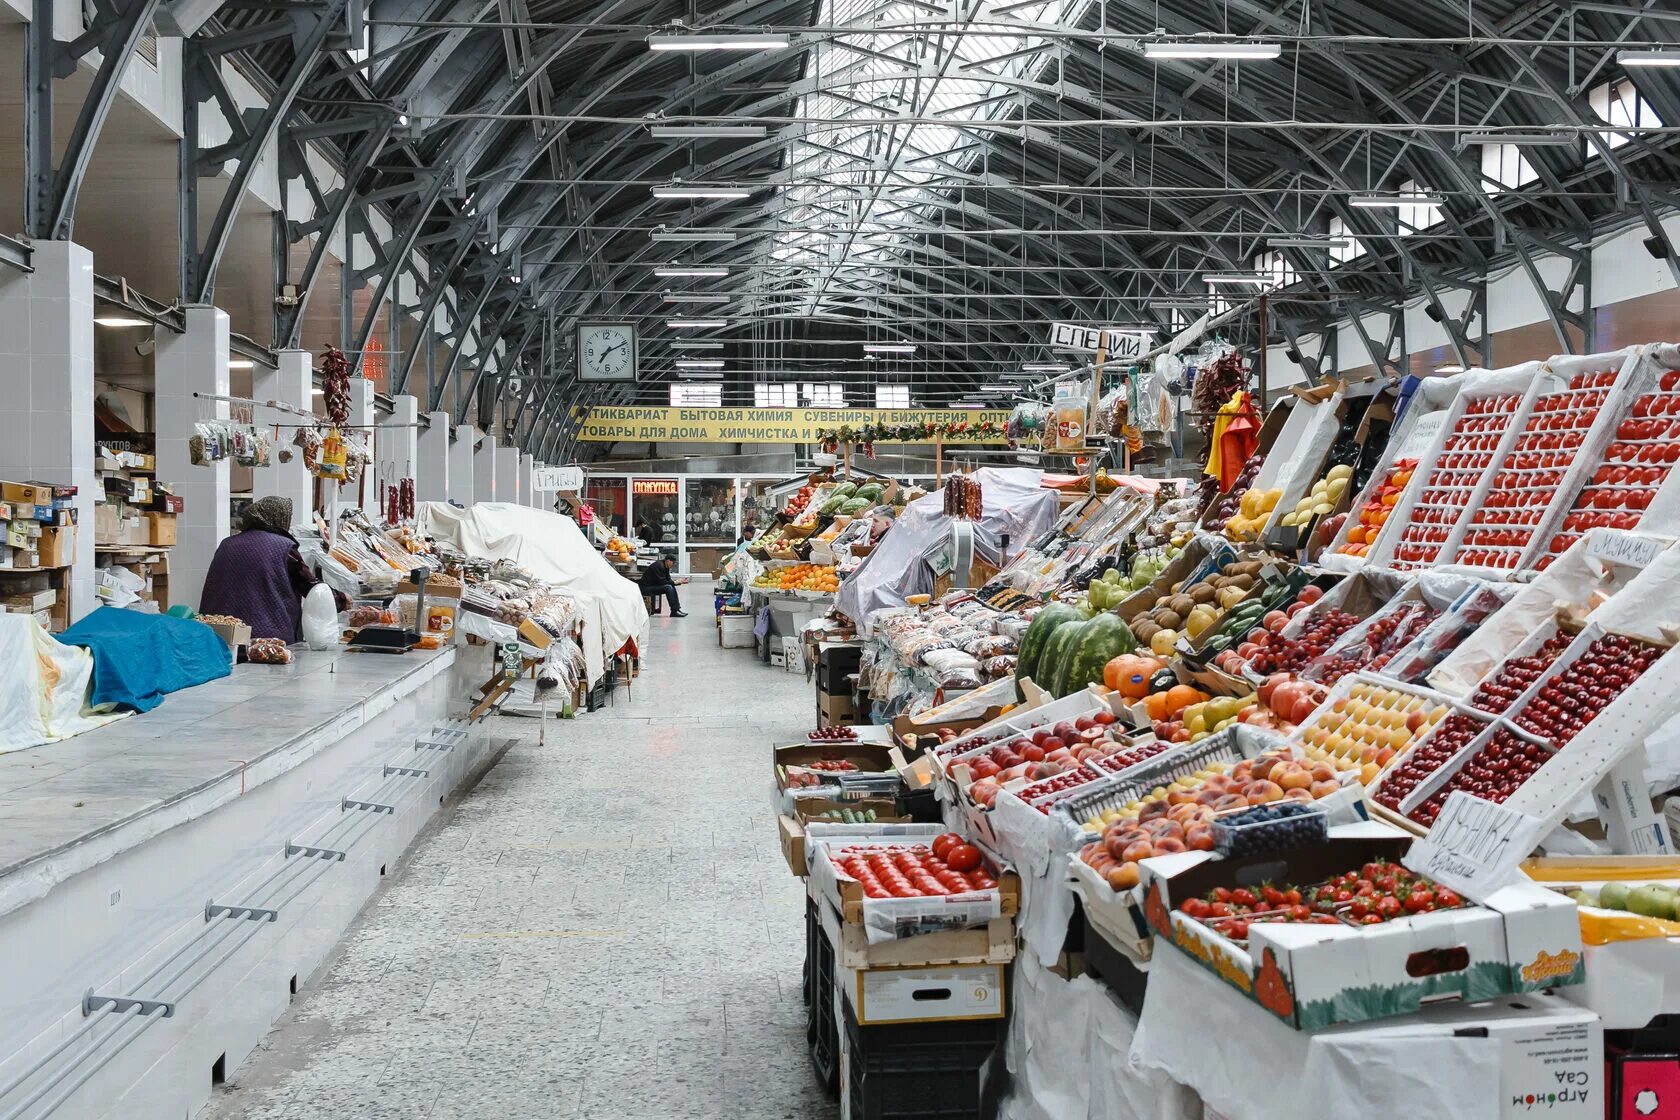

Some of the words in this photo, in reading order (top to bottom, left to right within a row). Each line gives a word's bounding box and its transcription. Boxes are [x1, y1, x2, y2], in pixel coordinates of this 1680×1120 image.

[602, 331, 611, 340] 12
[1055, 325, 1141, 356] СПЕЦИИ
[588, 348, 594, 357] 9
[620, 347, 627, 356] 3
[604, 363, 611, 372] 6
[680, 410, 743, 421] БЫТОВАЯ
[748, 411, 793, 422] ХИМИЯ
[804, 411, 874, 422] СУВЕНИРЫ
[880, 412, 887, 422] И
[891, 412, 968, 423] БИЖУТЕРИЯ
[582, 425, 635, 437] ТОВАРЫ
[639, 426, 666, 439] ДЛЯ
[670, 427, 708, 440] ДОМА
[719, 428, 798, 439] ХИМЧИСТКА
[802, 428, 811, 439] И
[537, 470, 578, 488] ГРИБЫ
[633, 481, 676, 493] ПОКУПКА
[1554, 1069, 1589, 1085] Сад
